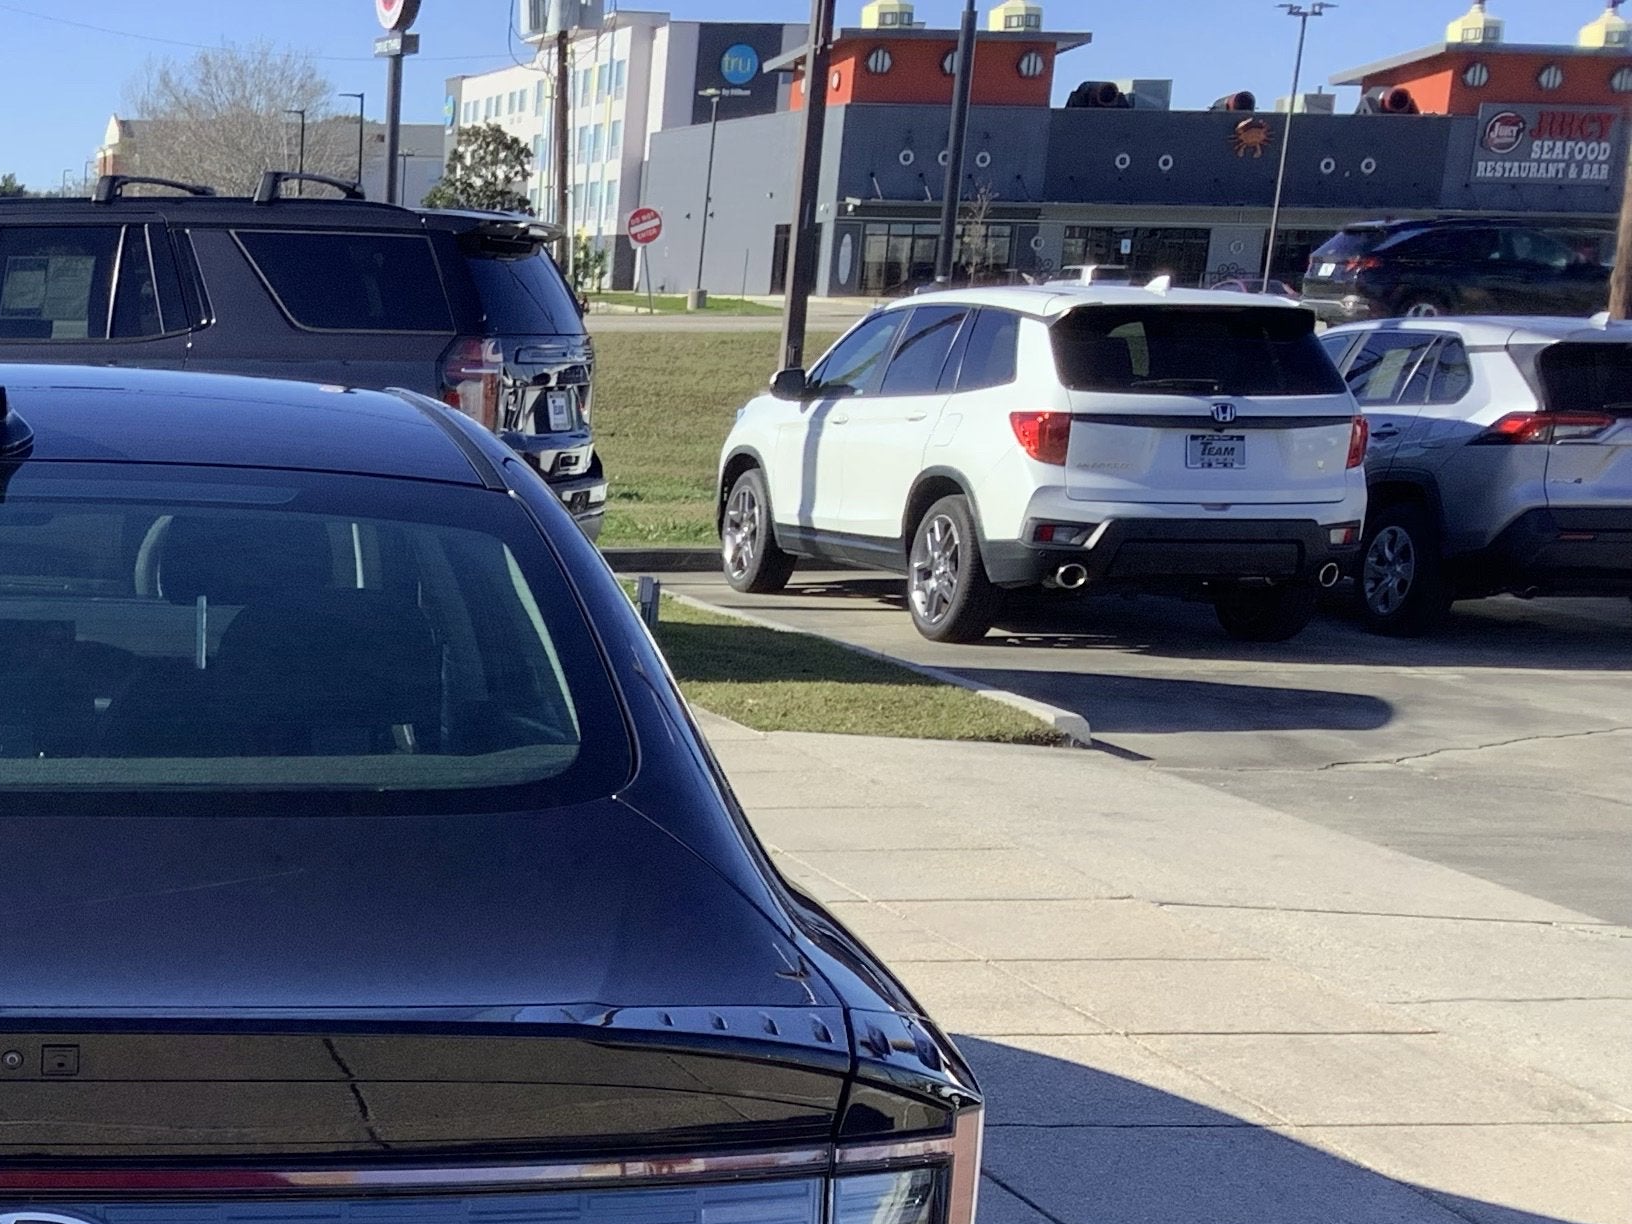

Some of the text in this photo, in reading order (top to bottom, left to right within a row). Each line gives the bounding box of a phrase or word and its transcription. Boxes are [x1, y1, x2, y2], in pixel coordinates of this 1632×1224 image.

[1529, 111, 1614, 140] JUICY
[1531, 140, 1611, 160] SEAFOOD
[1476, 161, 1609, 179] RESTAURANT & BAR
[1200, 442, 1235, 456] TEAM
